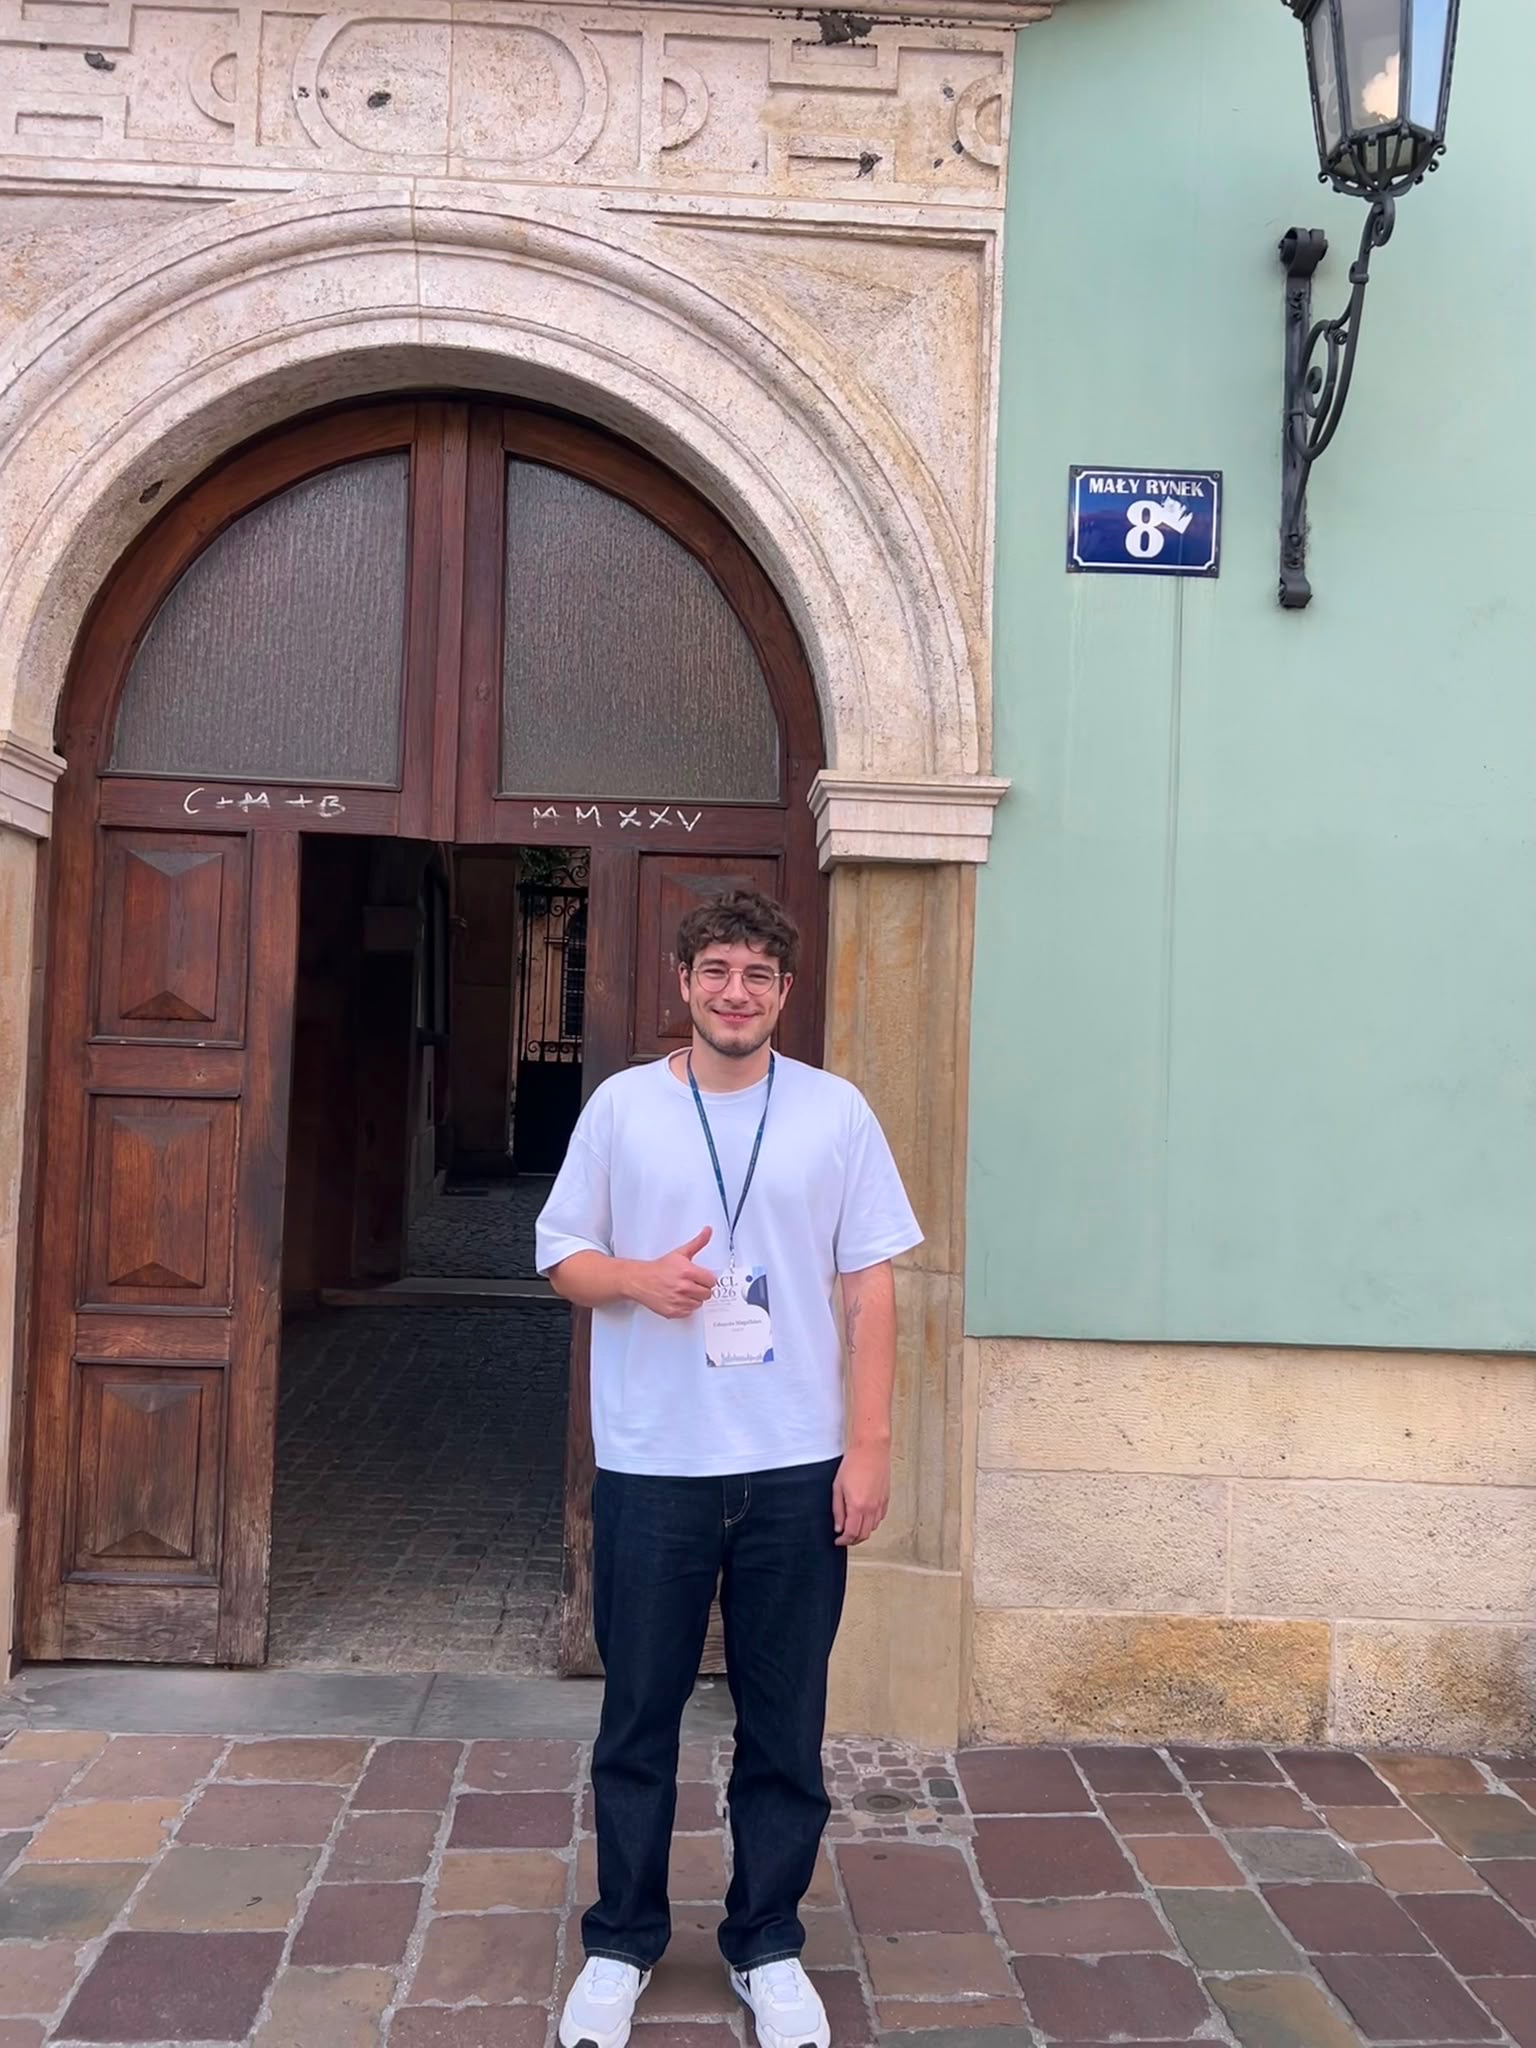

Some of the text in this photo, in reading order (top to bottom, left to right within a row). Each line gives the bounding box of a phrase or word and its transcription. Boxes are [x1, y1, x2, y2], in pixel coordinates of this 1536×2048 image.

[1089, 478, 1205, 497] MAŁY RYNEK
[1125, 500, 1165, 559] 8
[711, 1288, 737, 1299] 026
